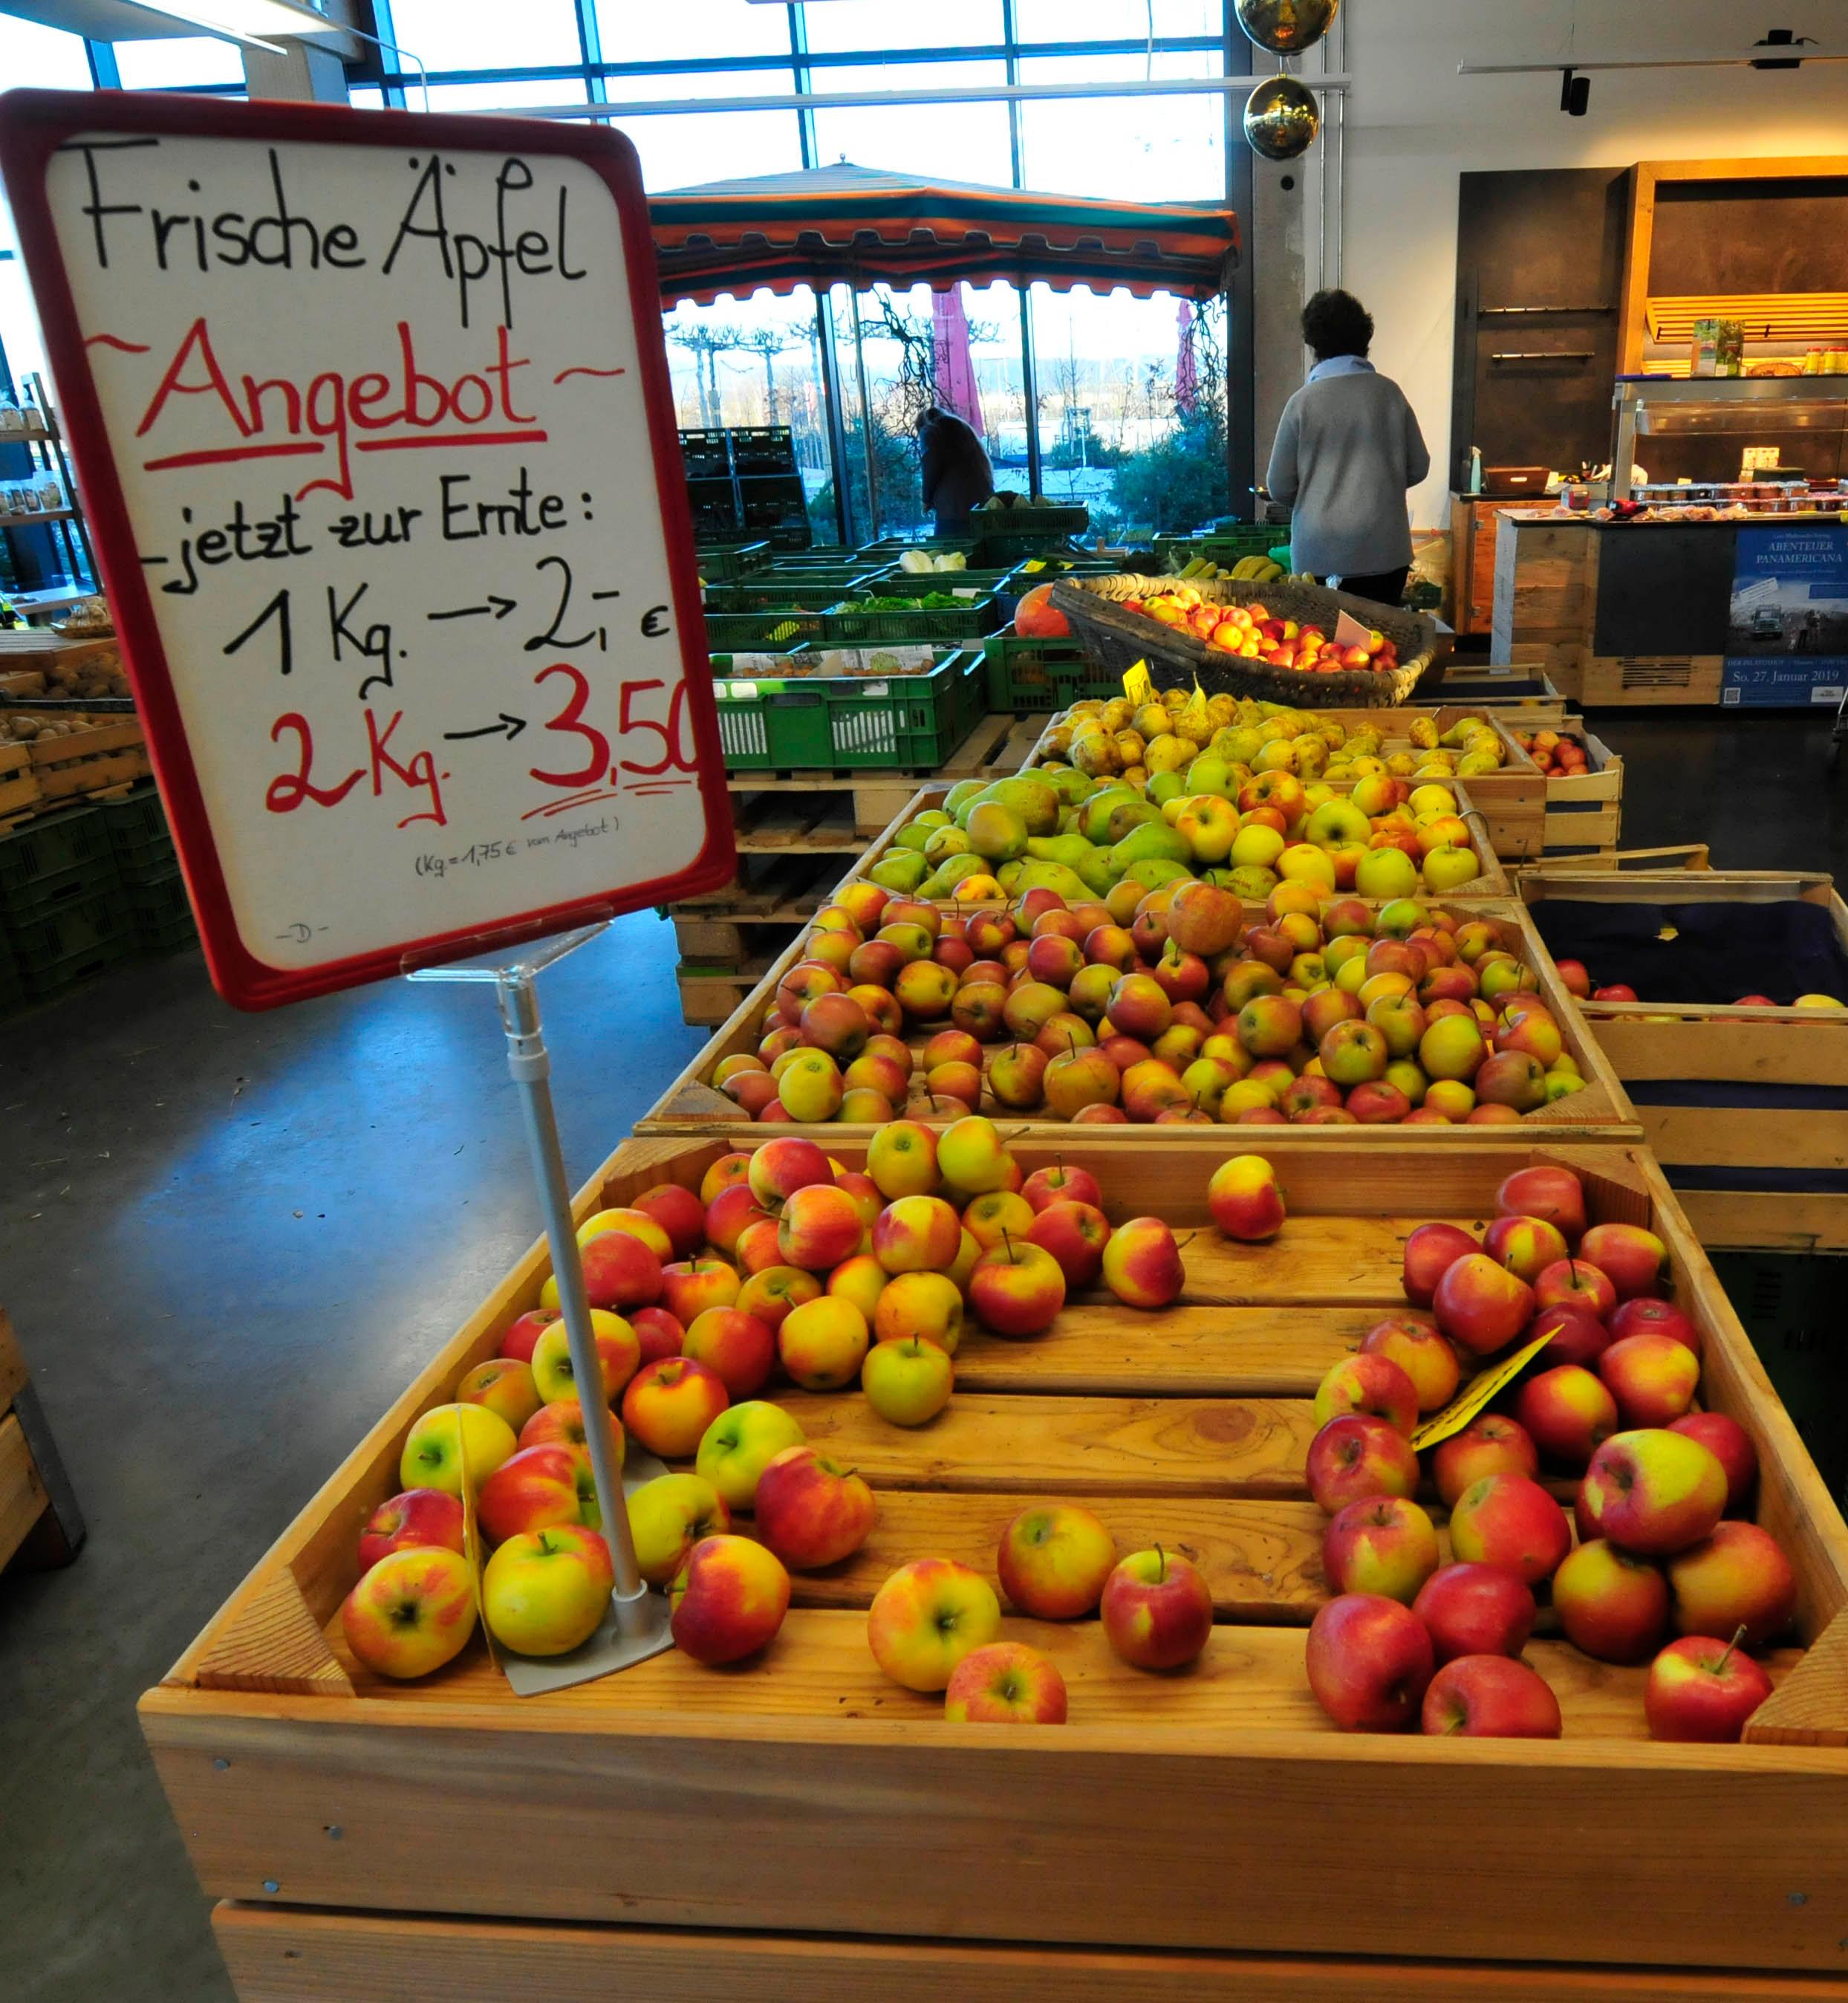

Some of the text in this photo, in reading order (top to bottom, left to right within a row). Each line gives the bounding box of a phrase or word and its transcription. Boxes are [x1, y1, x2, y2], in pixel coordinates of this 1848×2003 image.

[61, 138, 587, 329] Frische Äpfel
[136, 317, 538, 501] Angebot
[328, 507, 423, 548] zur
[1756, 553, 1843, 565] PANAMERICANA
[1769, 541, 1834, 551] ABENTEUER
[223, 588, 292, 675] 1
[641, 605, 670, 637] €
[1733, 670, 1840, 684] So. 27. Januar 2019
[265, 712, 367, 814] 2
